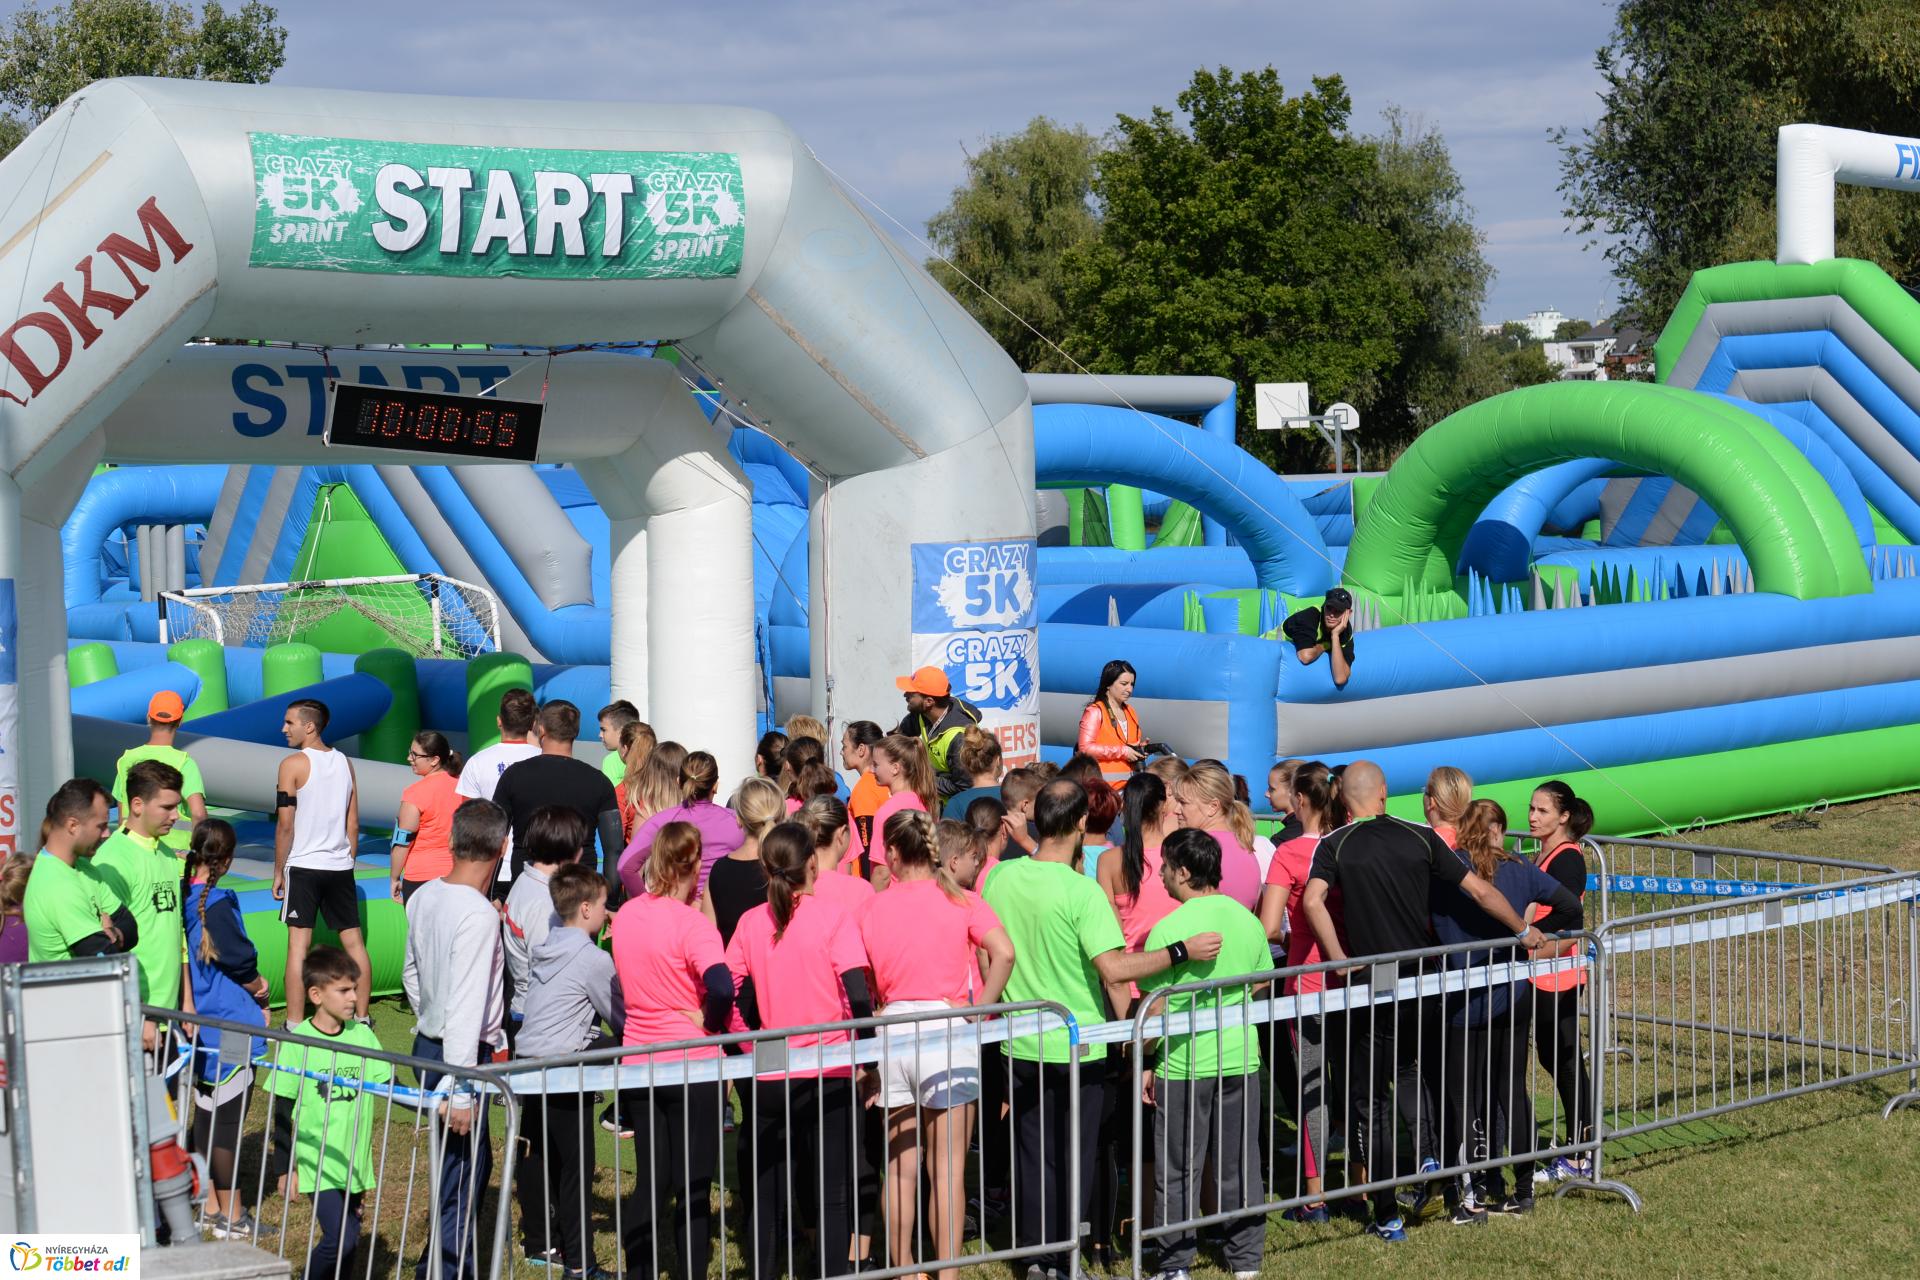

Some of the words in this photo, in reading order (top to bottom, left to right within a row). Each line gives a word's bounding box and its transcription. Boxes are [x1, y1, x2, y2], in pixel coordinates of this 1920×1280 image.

[265, 154, 353, 180] CRAZY
[1895, 143, 1920, 179] FI
[283, 177, 340, 213] 5K
[648, 171, 731, 193] CRAZY
[371, 163, 637, 257] START
[664, 192, 721, 226] 5K
[269, 221, 350, 244] SPRINT
[651, 234, 728, 261] SPRINT
[0, 196, 194, 407] DKM
[371, 402, 516, 447] 10:00:55
[944, 543, 1029, 575] CRAZY
[965, 571, 1021, 617] 5K
[946, 634, 1029, 664] CRAZY
[965, 659, 1021, 702] 5K
